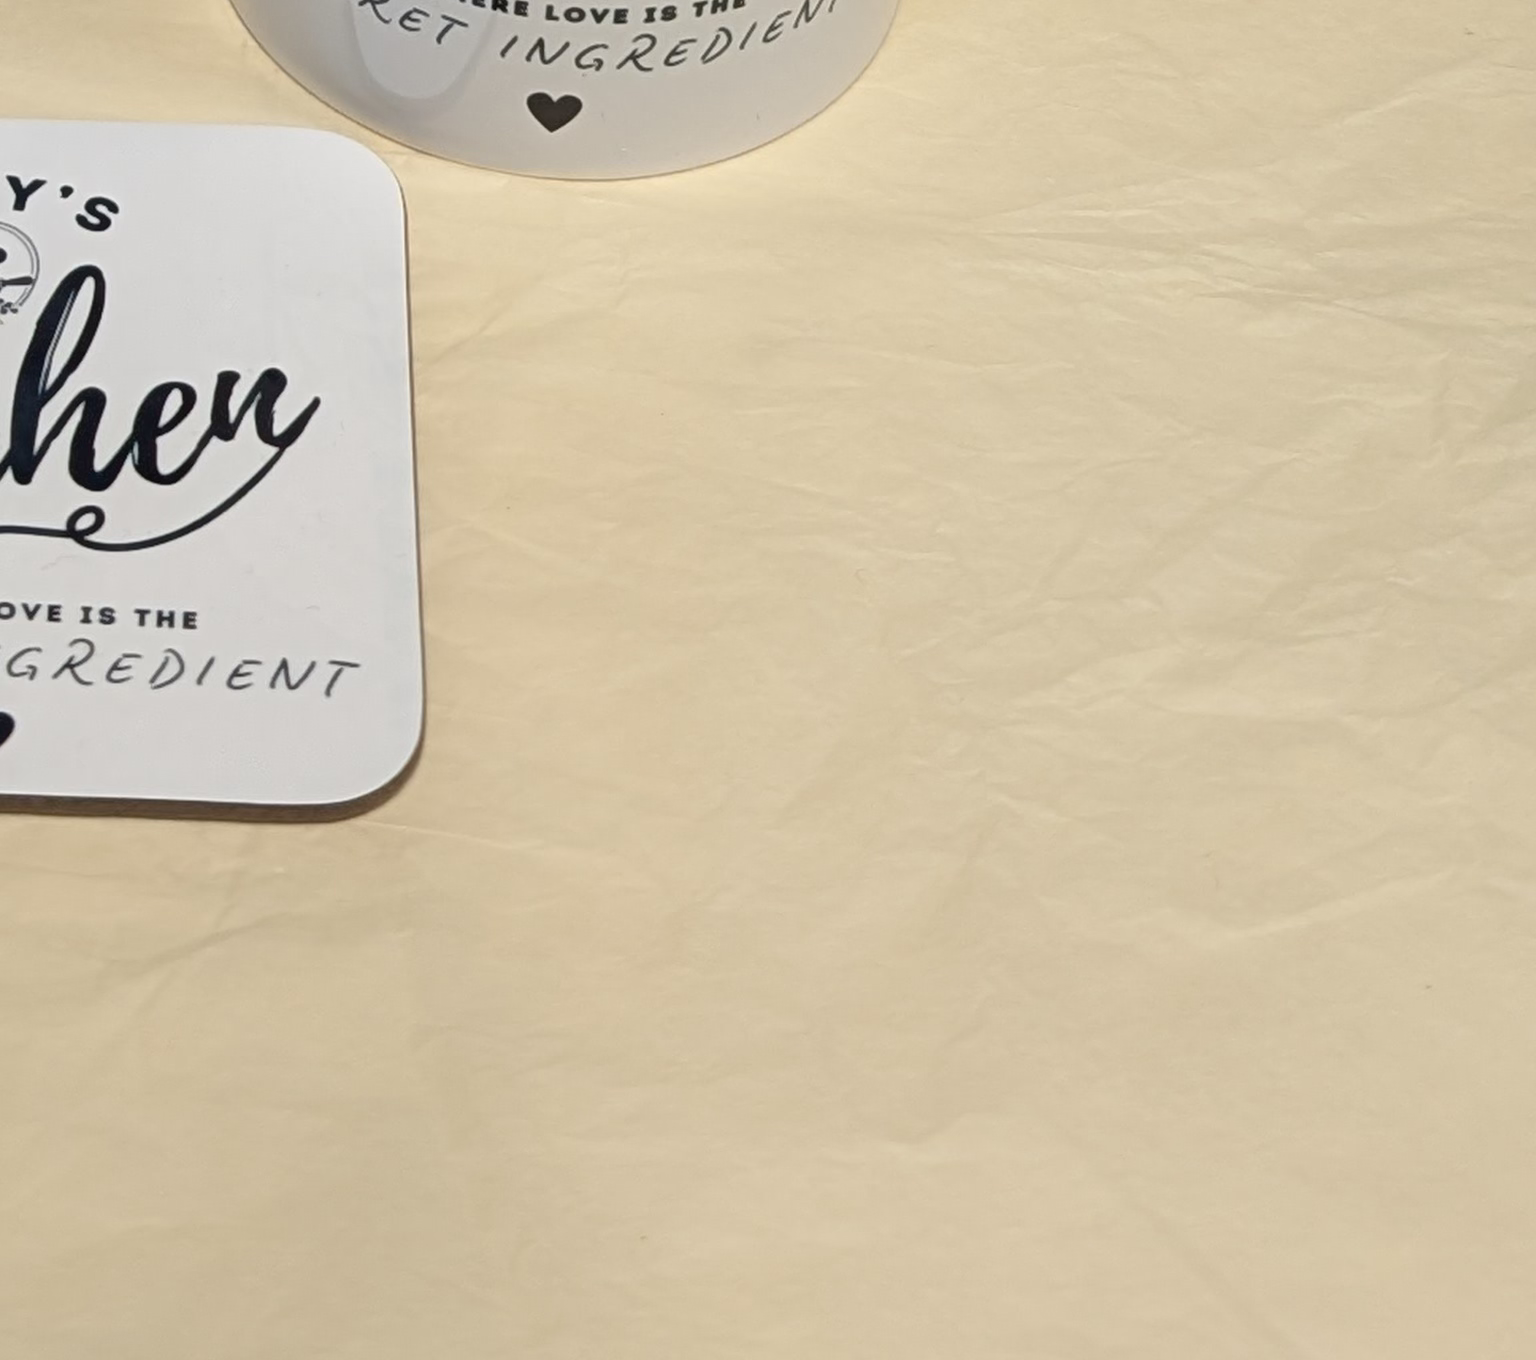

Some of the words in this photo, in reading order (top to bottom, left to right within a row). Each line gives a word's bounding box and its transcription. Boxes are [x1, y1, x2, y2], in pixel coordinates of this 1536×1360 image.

[545, 4, 629, 25] LOVE
[643, 5, 678, 22] IS
[79, 606, 117, 626] IS
[133, 608, 199, 630] THE
